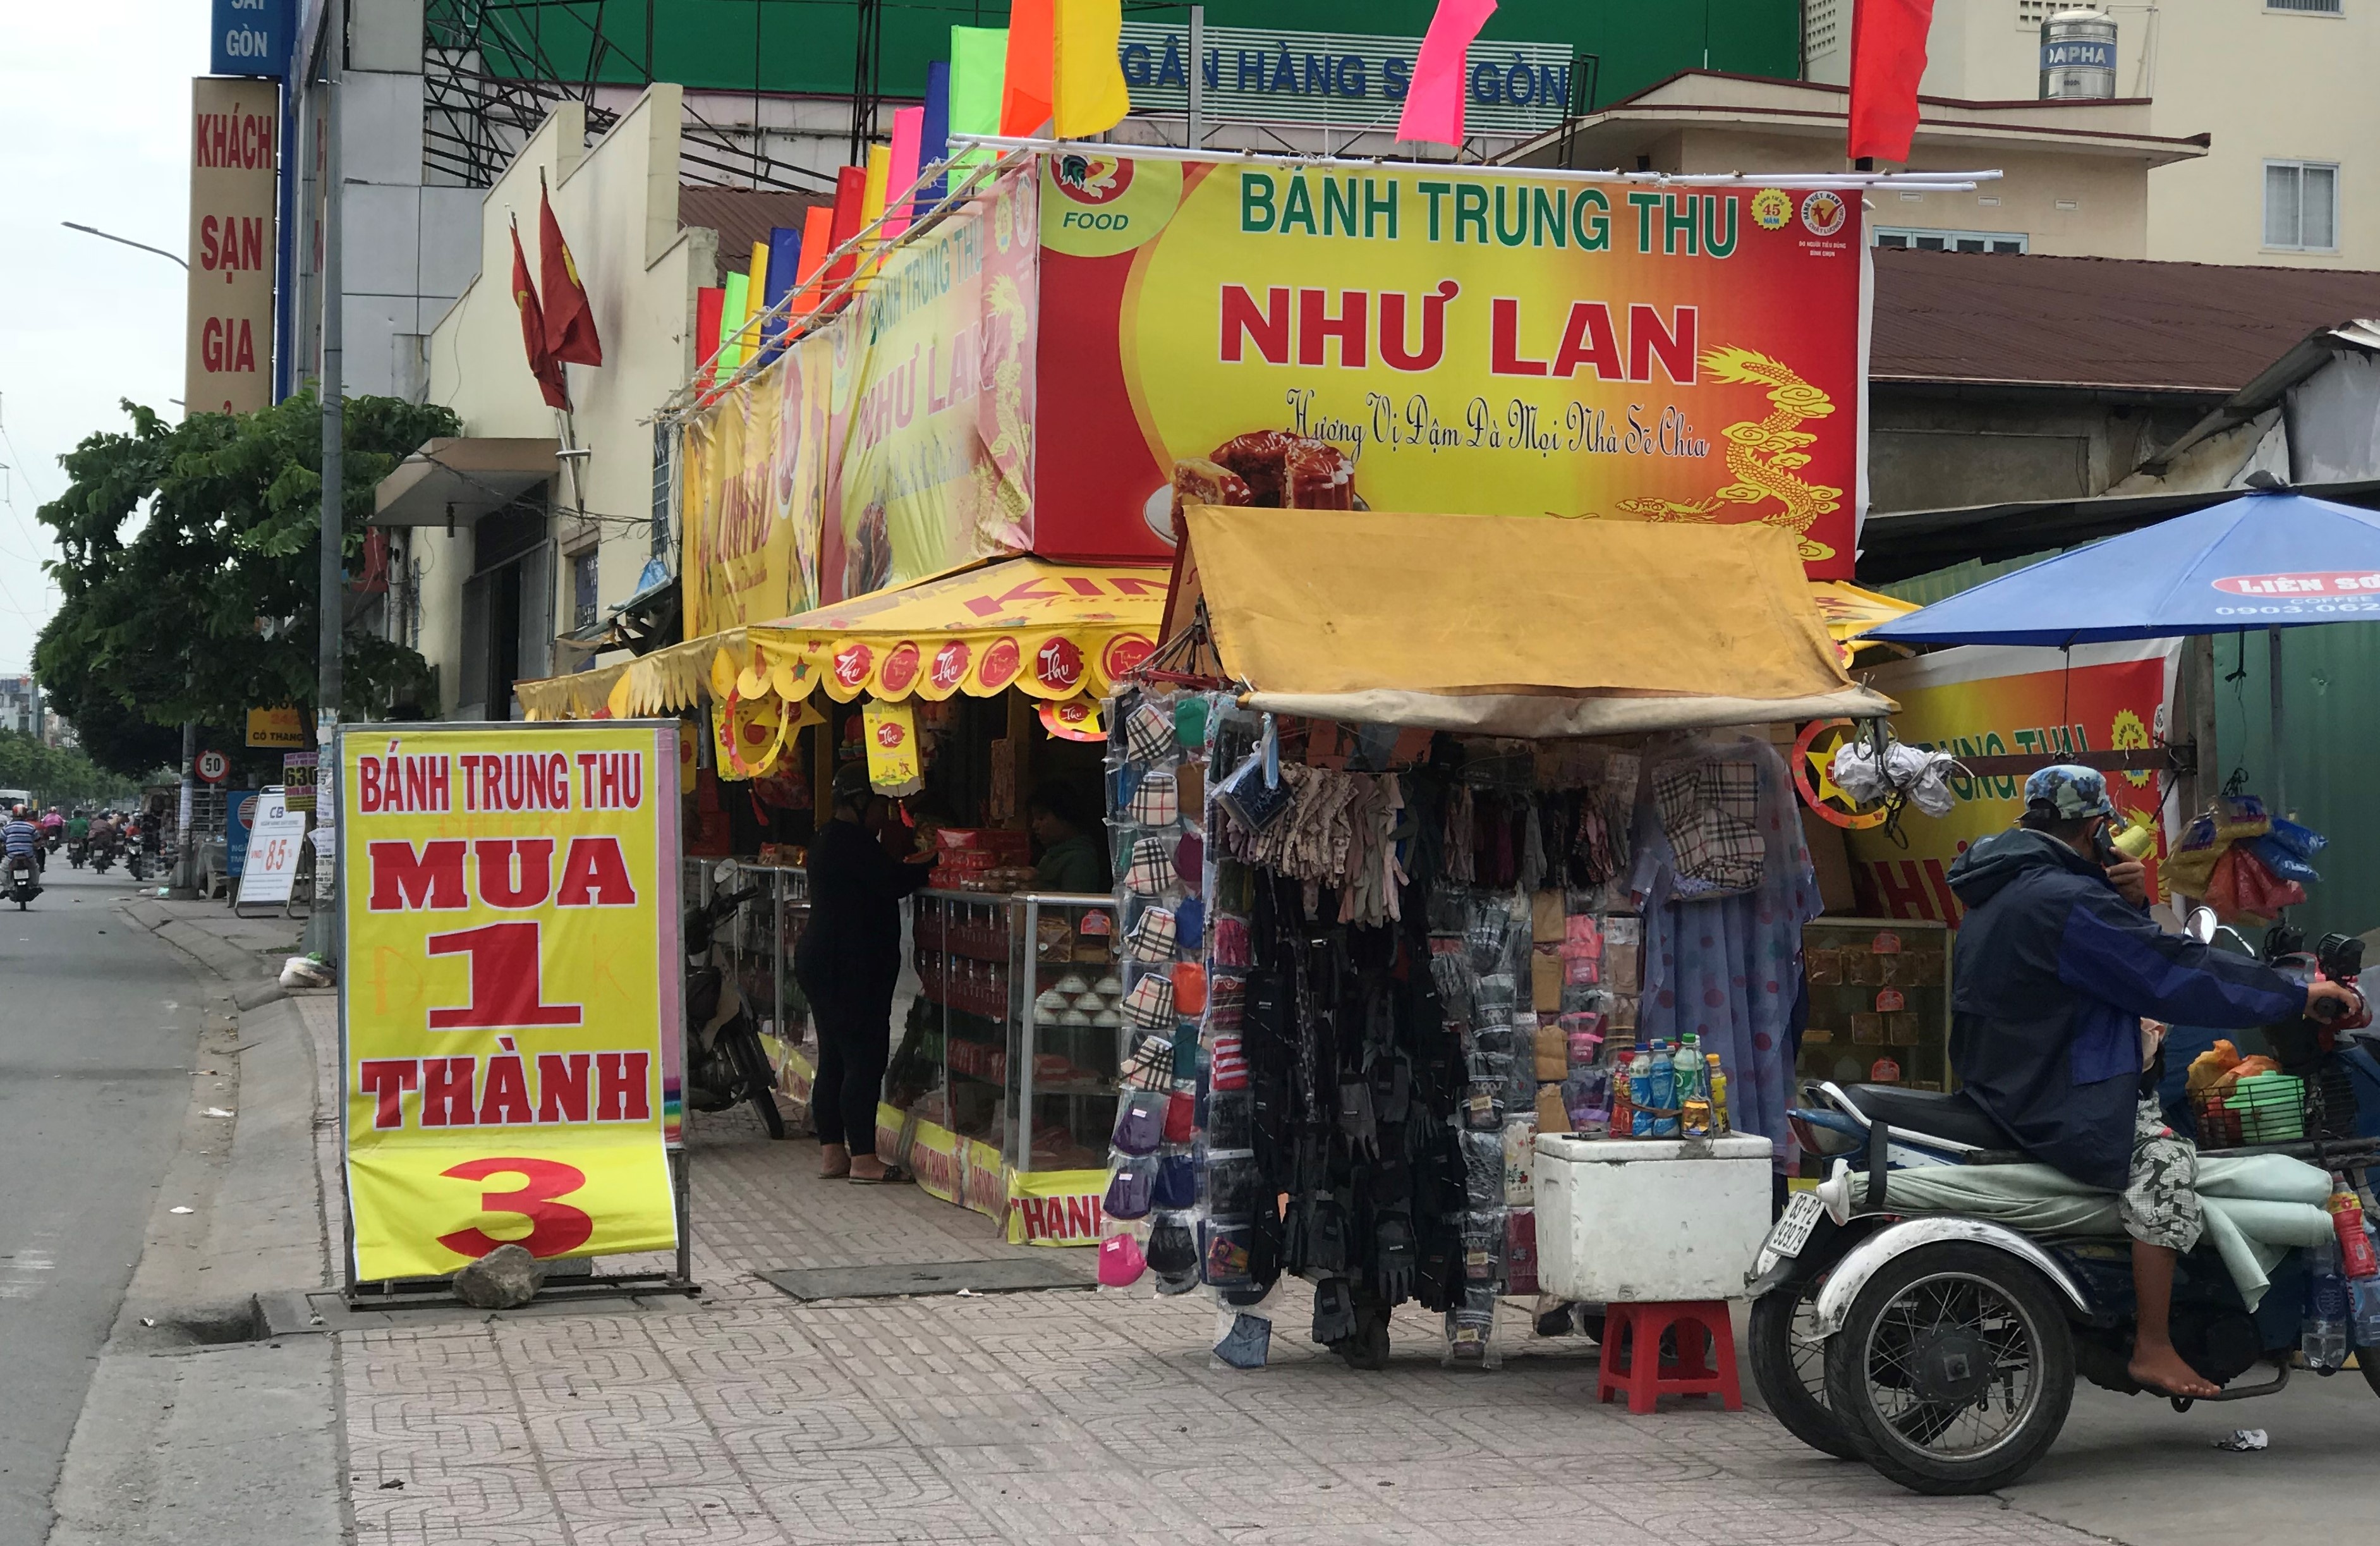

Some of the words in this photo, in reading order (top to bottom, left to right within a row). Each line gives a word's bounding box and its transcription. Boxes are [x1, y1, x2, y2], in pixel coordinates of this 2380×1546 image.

[226, 23, 267, 58] GÒN
[1120, 34, 1219, 88] GÂN
[1237, 40, 1366, 97] HÀNG
[1471, 51, 1567, 106] GÒN
[197, 102, 272, 170] KHÁCH
[1062, 212, 1129, 231] FOOD
[1241, 164, 1398, 240] BÁNH
[1418, 181, 1612, 252] TRUNG
[1628, 192, 1739, 257] THU
[1762, 204, 1781, 216] 45
[1825, 193, 1841, 205] NAM
[200, 214, 263, 284] SẠN
[905, 237, 950, 315] TRUNG
[954, 211, 983, 283] THU
[202, 316, 255, 373] GIA
[1220, 279, 1460, 372] NHƯ
[1491, 298, 1697, 384] LAN
[857, 342, 921, 456] NHƯ
[928, 313, 999, 417] LAN
[1286, 388, 1366, 465] Hương
[1366, 392, 1402, 453] Vị
[1405, 394, 1464, 454] Đậm
[1466, 397, 1504, 448] Đà
[1507, 398, 1562, 458] Mọi
[1566, 401, 1622, 453] Nhà
[1625, 403, 1656, 455] Sẽ
[1659, 405, 1710, 458] Chia
[2238, 577, 2325, 593] LIÊN
[2290, 595, 2374, 605] COFFEE
[835, 650, 862, 685] Thu
[931, 647, 961, 683] Thu
[1038, 643, 1080, 684] Thu
[878, 725, 899, 745] Thu
[1062, 706, 1086, 721] Thu
[205, 757, 221, 772] 50
[360, 740, 449, 812] BÁNH
[460, 753, 569, 810] TRUNG
[578, 752, 641, 809] THU
[1917, 731, 2019, 801] UNG
[369, 837, 636, 910] MUA
[428, 922, 582, 1028] 1
[361, 1037, 650, 1129] THÀNH
[435, 1157, 593, 1258] 3
[1789, 1194, 1821, 1226] 83-P2
